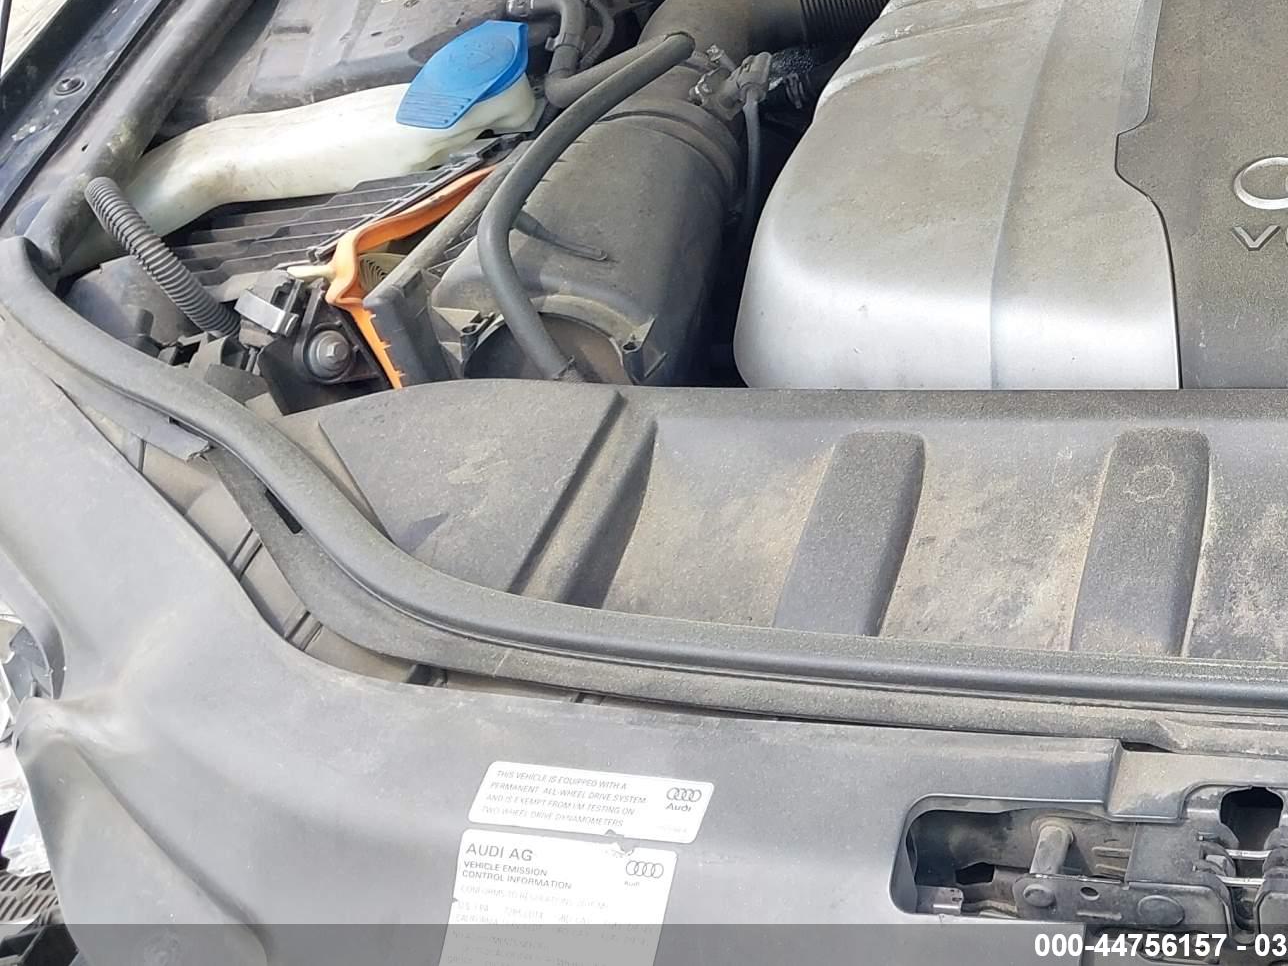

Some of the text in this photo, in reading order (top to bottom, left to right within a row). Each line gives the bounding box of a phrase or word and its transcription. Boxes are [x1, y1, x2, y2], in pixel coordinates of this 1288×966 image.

[516, 771, 546, 782] VEHICLE
[599, 780, 620, 789] WITH
[665, 802, 692, 812] Audi
[465, 842, 534, 862] AUDI AG
[463, 860, 548, 876] VEHICLE EMISSION
[462, 869, 572, 889] CONTROL INFORMATION
